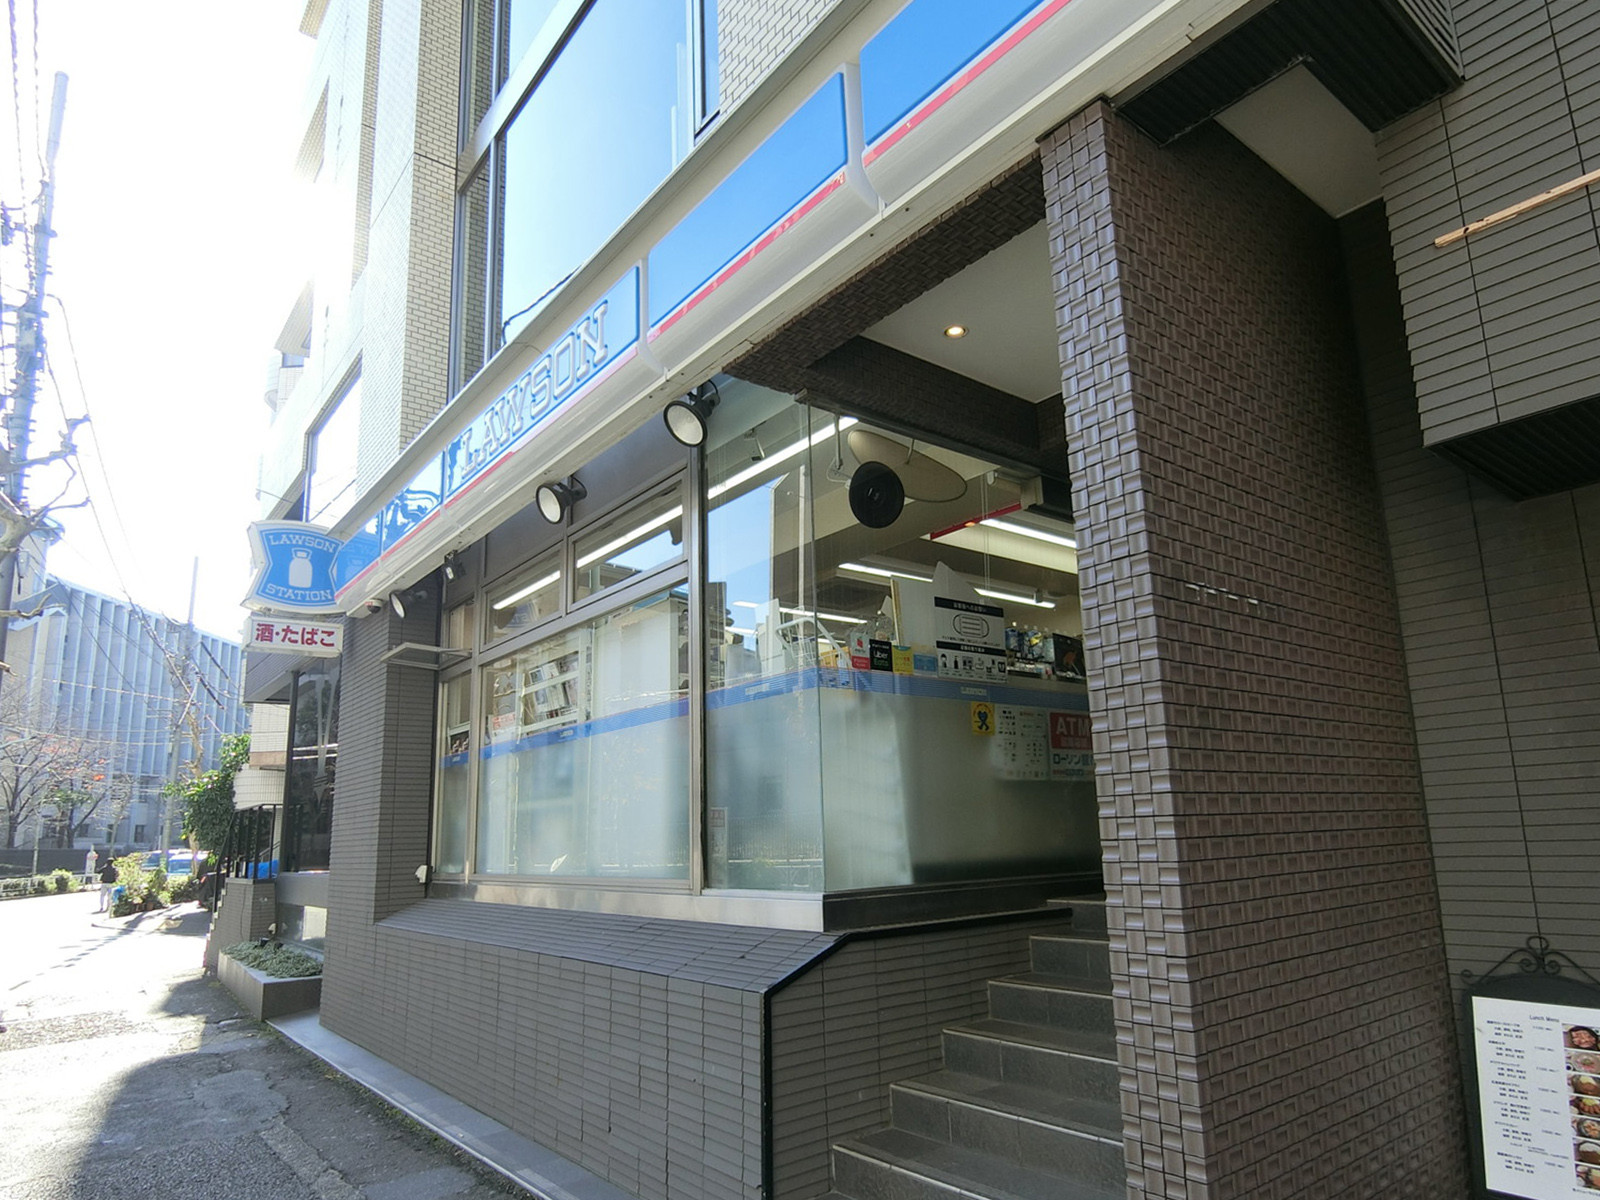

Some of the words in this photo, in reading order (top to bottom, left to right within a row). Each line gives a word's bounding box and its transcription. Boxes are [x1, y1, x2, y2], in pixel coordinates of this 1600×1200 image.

[461, 300, 608, 480] LAWSON
[269, 534, 336, 553] LAWSON
[265, 583, 332, 601] STATION
[255, 623, 335, 648] 酒・たばこ
[1056, 716, 1090, 737] ATM
